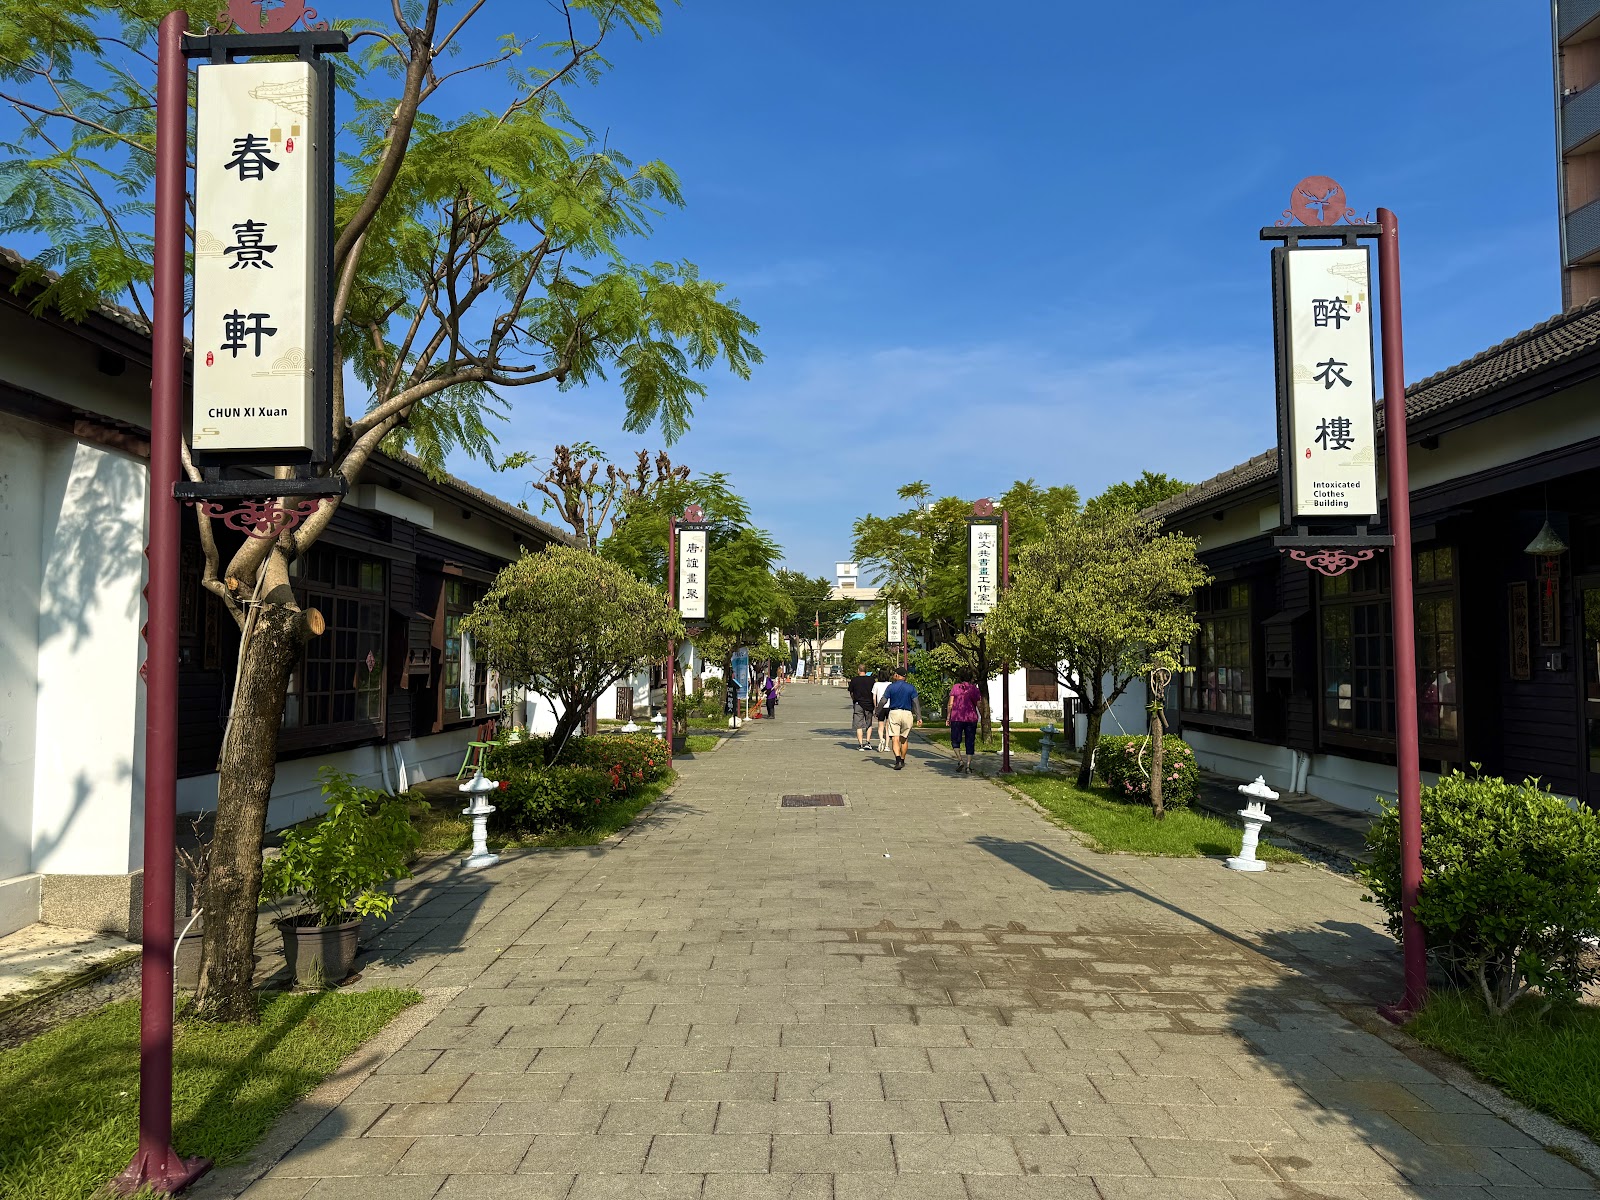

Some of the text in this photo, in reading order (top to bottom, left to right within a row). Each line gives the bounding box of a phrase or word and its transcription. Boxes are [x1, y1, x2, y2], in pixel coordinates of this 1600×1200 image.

[221, 133, 281, 359] 春熹軒
[1312, 296, 1355, 451] 醉衣樓
[208, 407, 287, 418] CHUN XI Xuan
[1313, 490, 1345, 498] Clothes
[1313, 499, 1349, 509] Building
[686, 543, 700, 600] 唐誼畫聚
